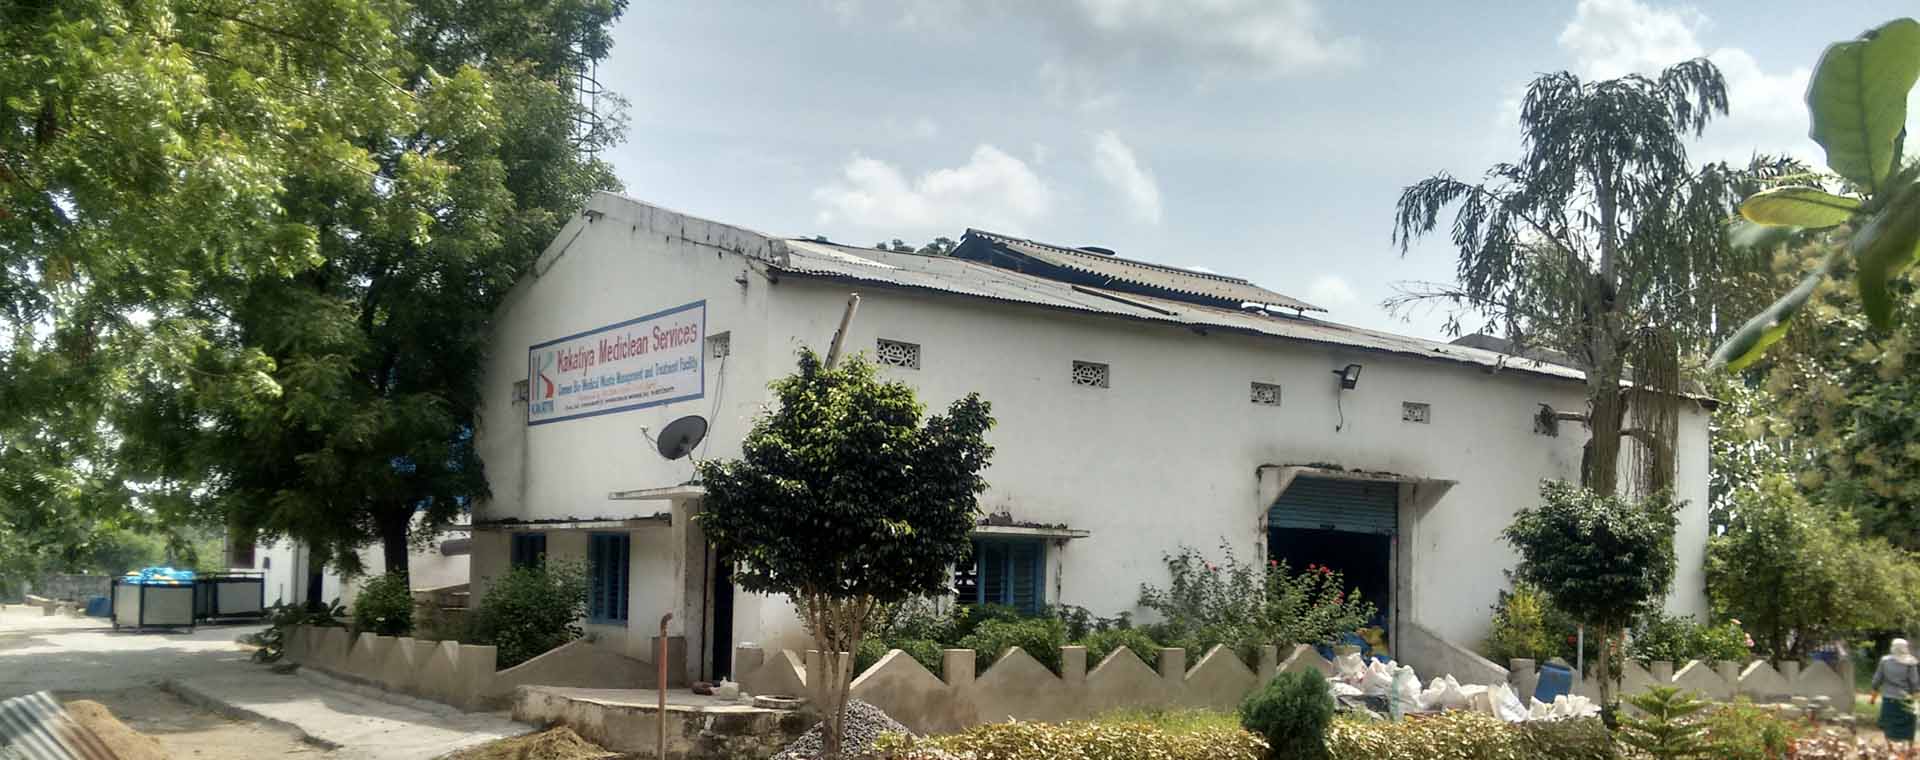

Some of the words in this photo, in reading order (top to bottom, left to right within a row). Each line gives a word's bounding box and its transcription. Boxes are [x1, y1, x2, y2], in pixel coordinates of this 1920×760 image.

[557, 347, 595, 376] Kakatiya
[599, 332, 649, 364] Mediclean
[652, 322, 697, 351] Services
